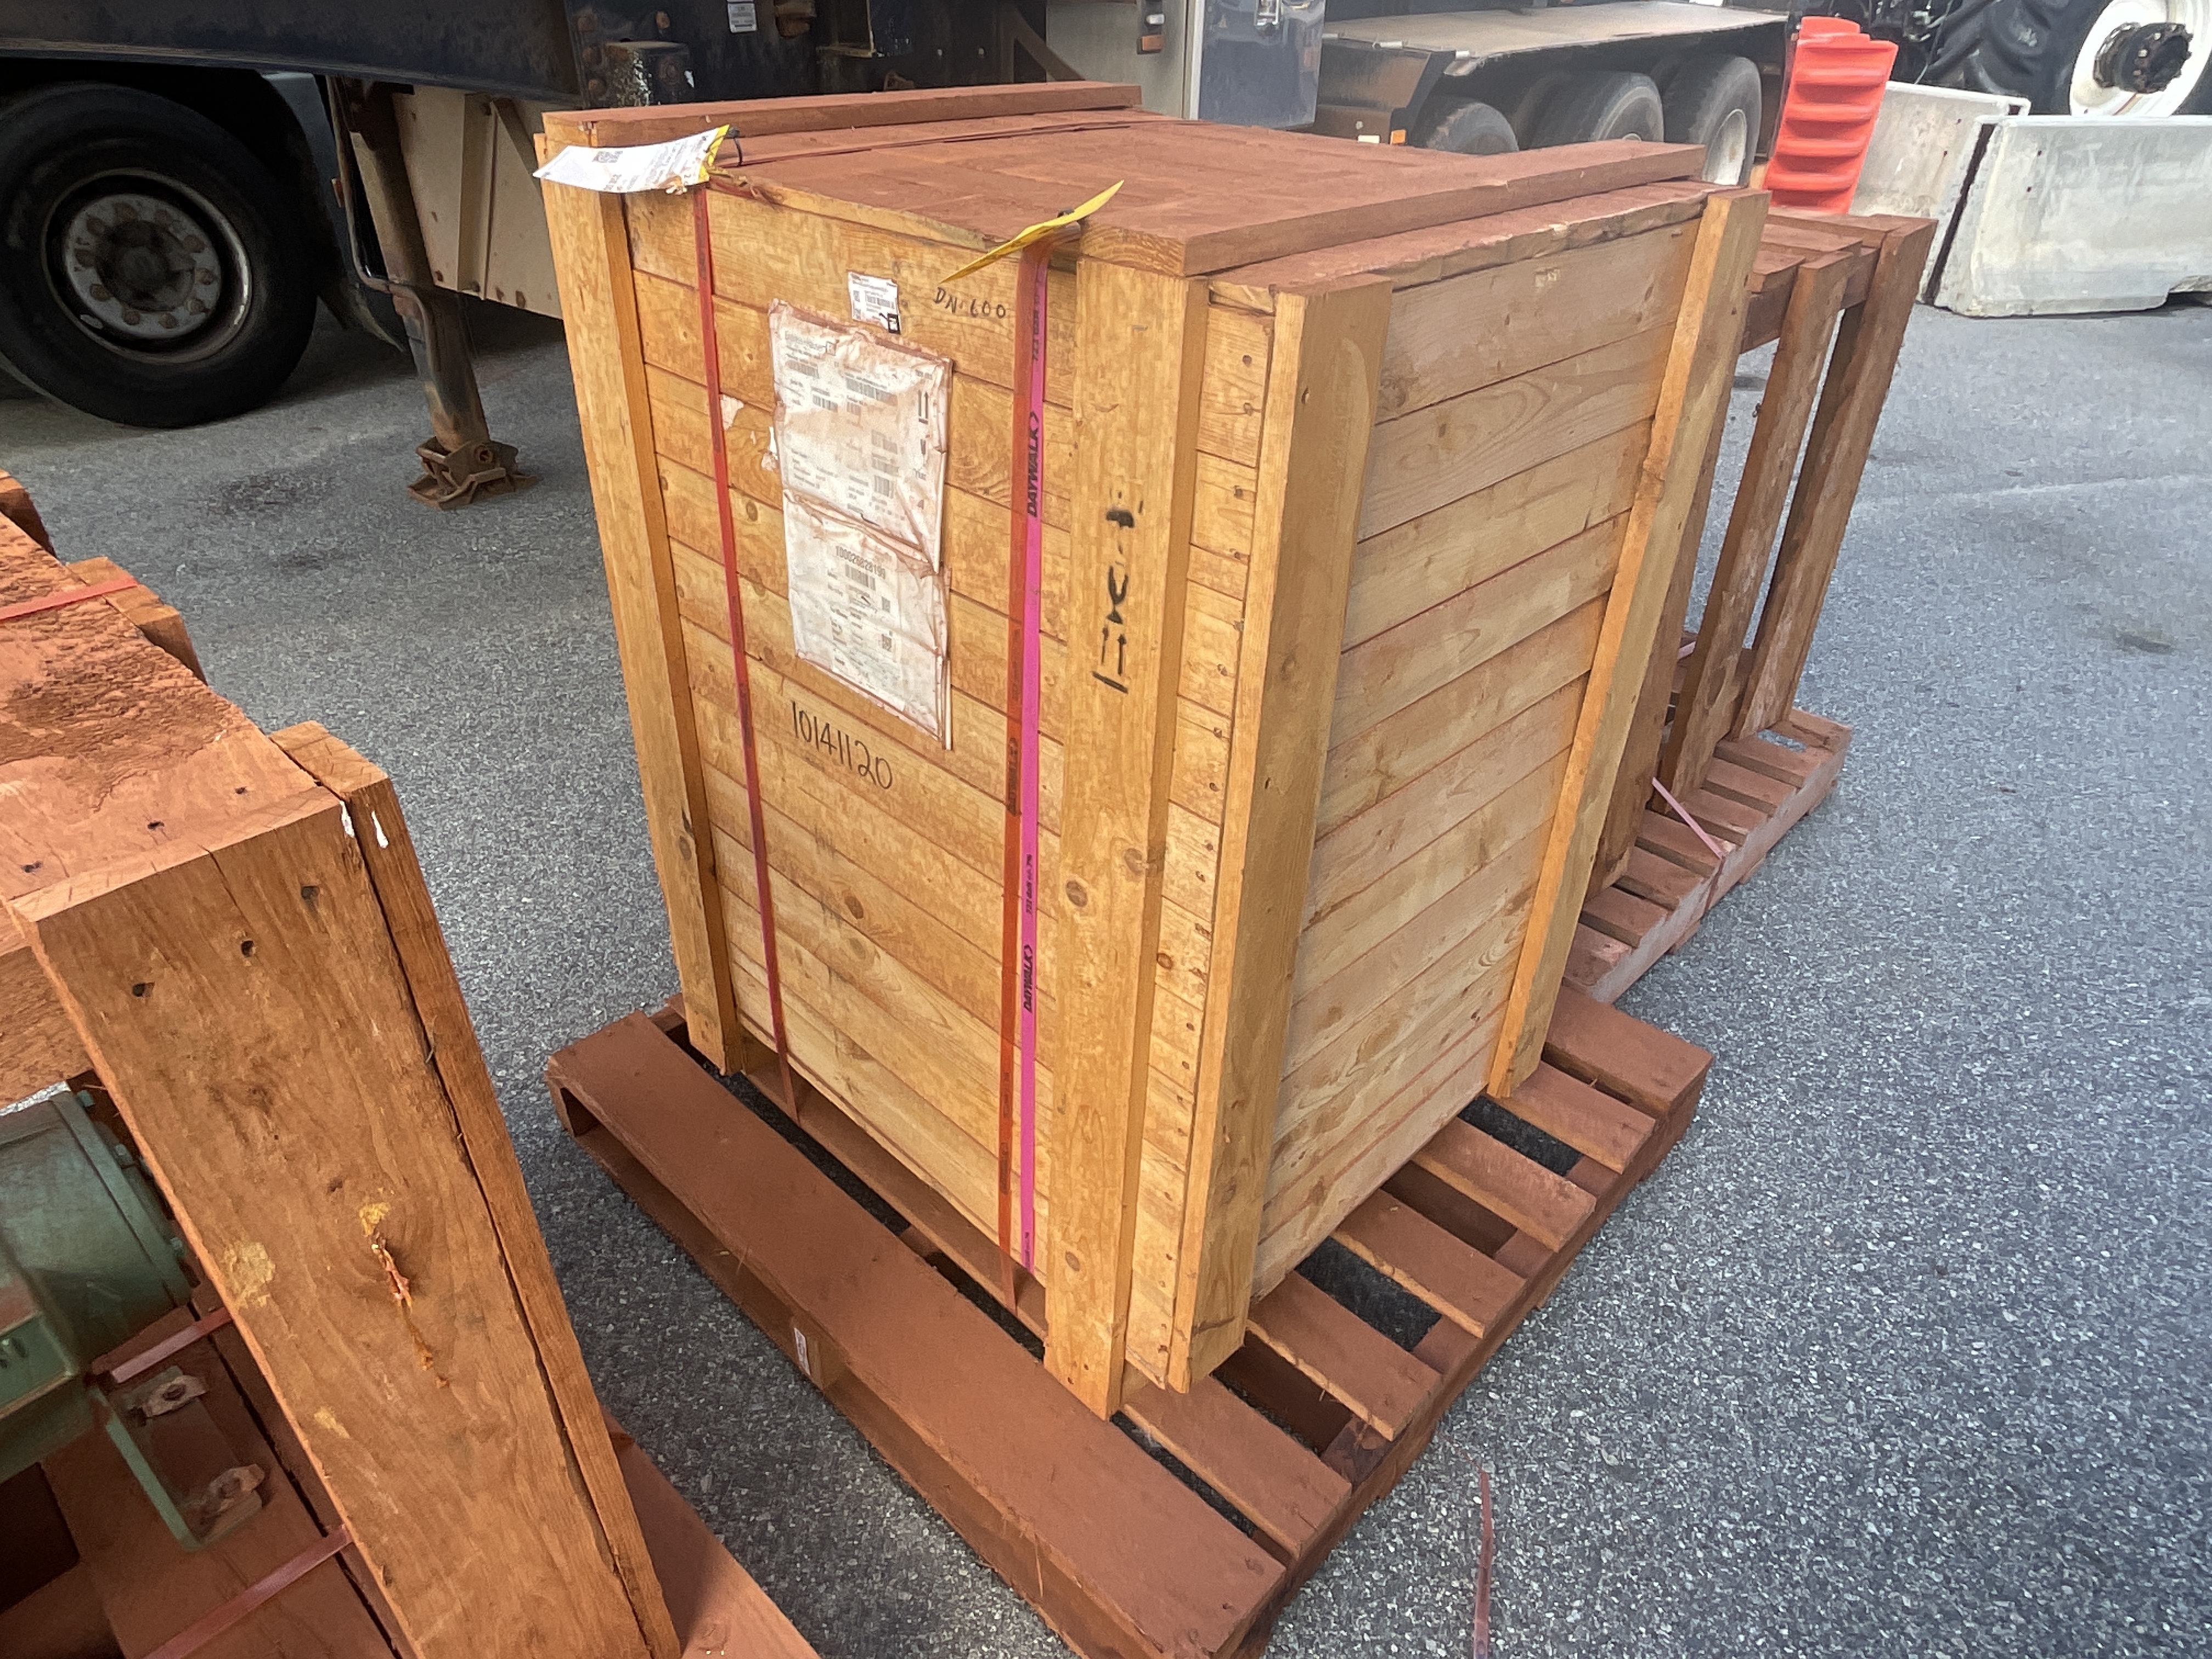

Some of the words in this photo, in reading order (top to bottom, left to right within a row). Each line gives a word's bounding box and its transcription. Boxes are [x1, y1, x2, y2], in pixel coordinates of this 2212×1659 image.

[970, 298, 1006, 319] 600
[1027, 428, 1039, 518] DAYWALK
[791, 700, 894, 790] 10141120
[1023, 953, 1033, 1013] DAYWALK
